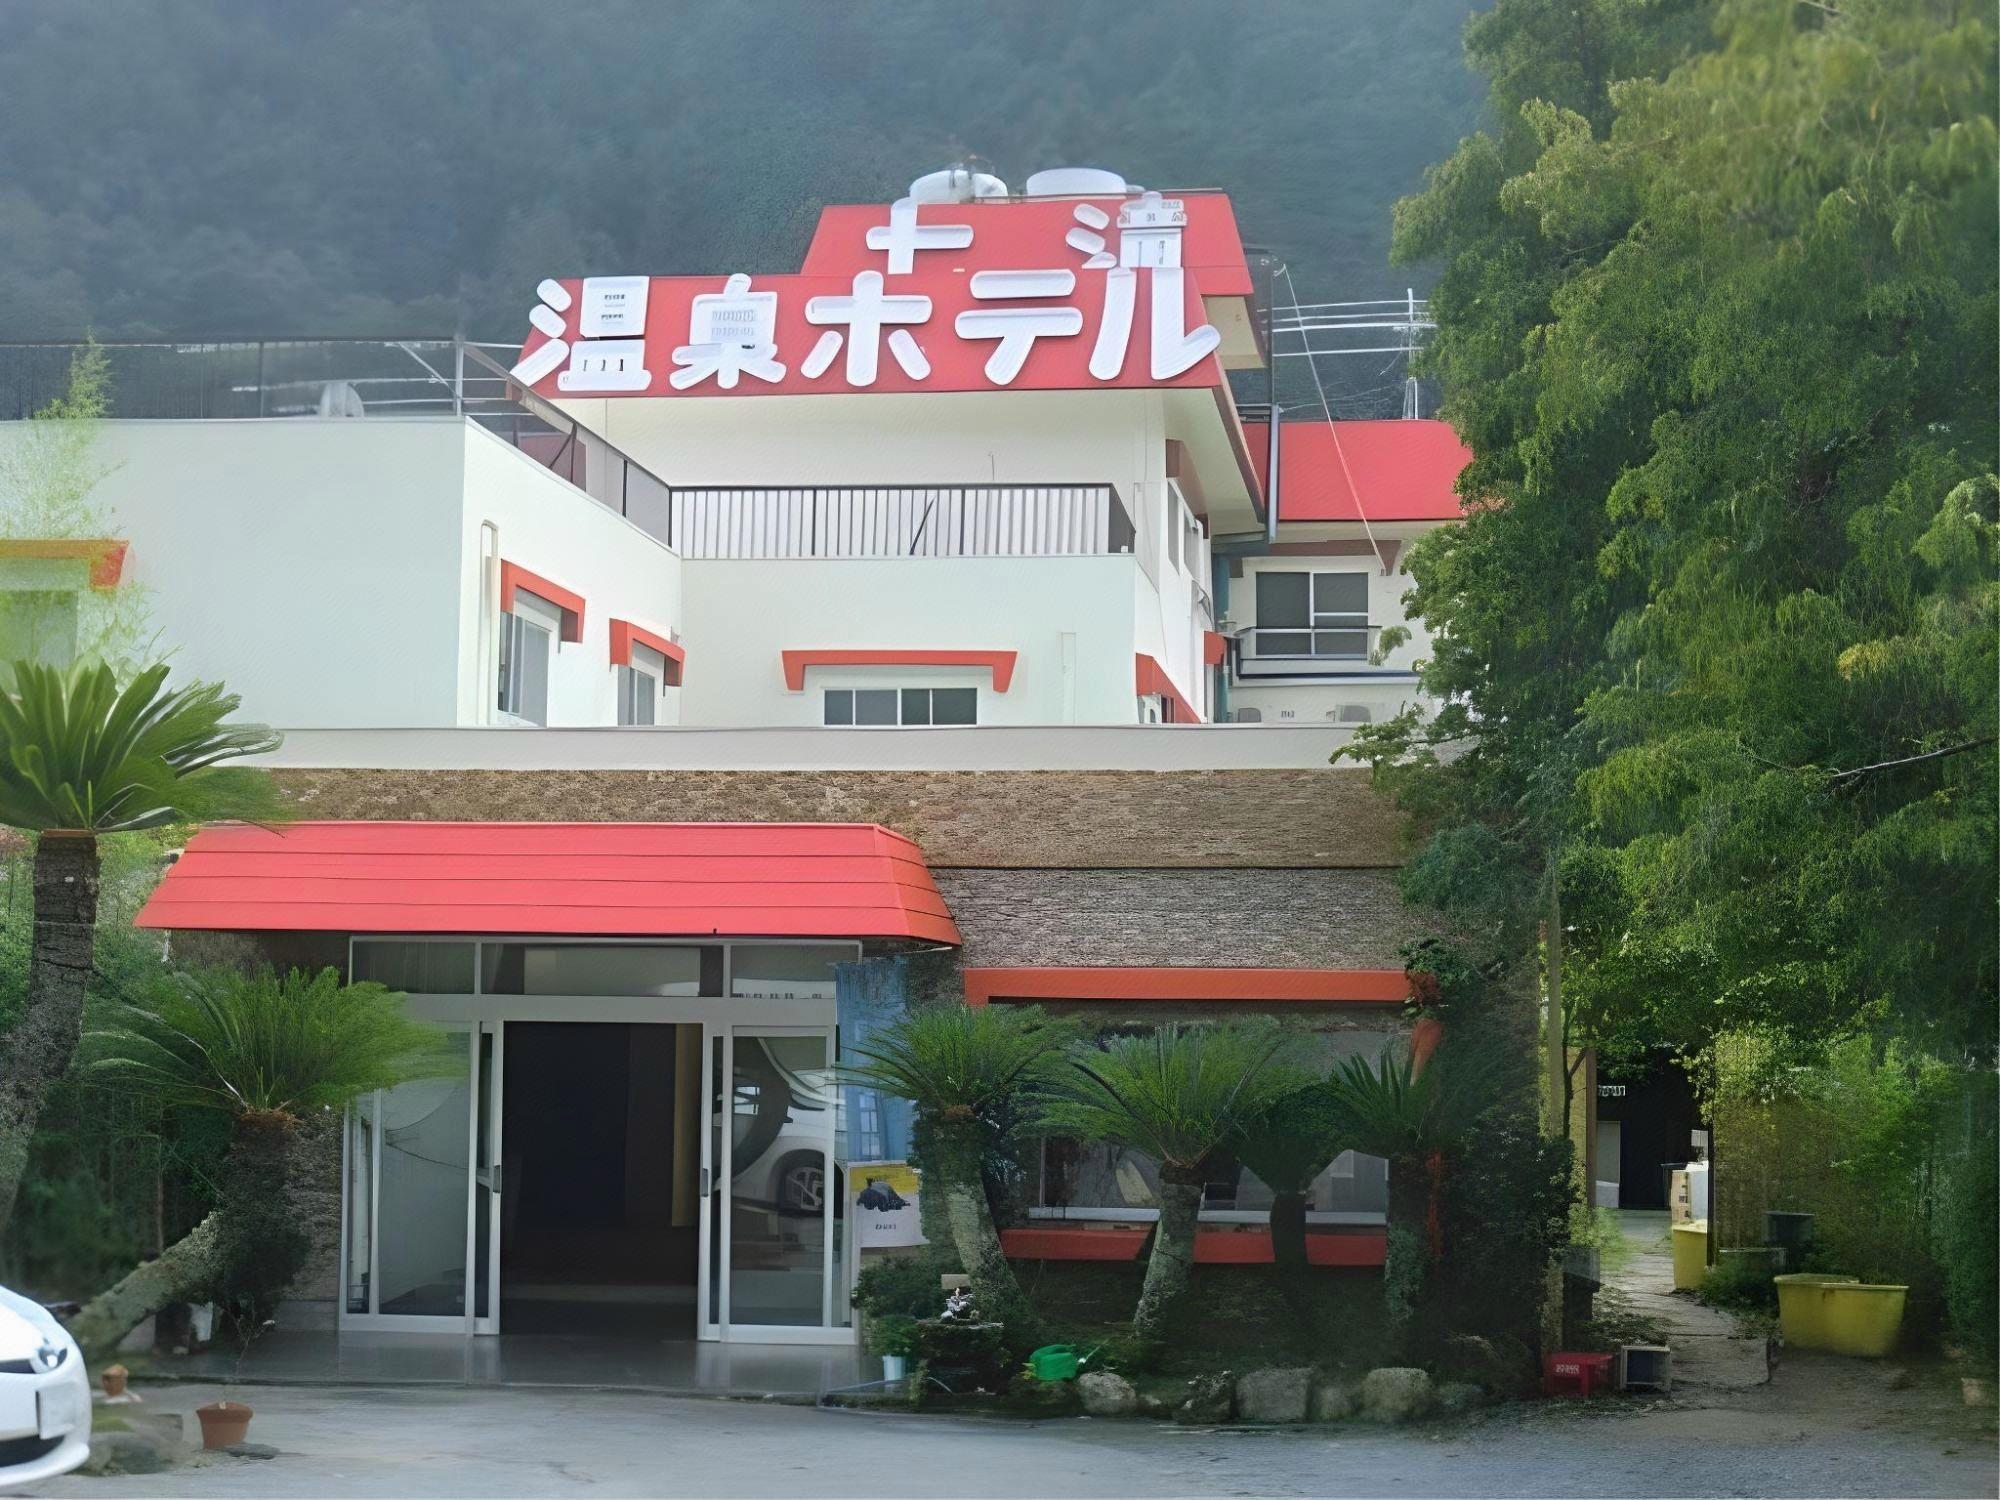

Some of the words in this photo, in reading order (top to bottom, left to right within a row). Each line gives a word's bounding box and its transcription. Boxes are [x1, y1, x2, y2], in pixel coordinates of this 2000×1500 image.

[509, 267, 1221, 391] 温泉ホテル
